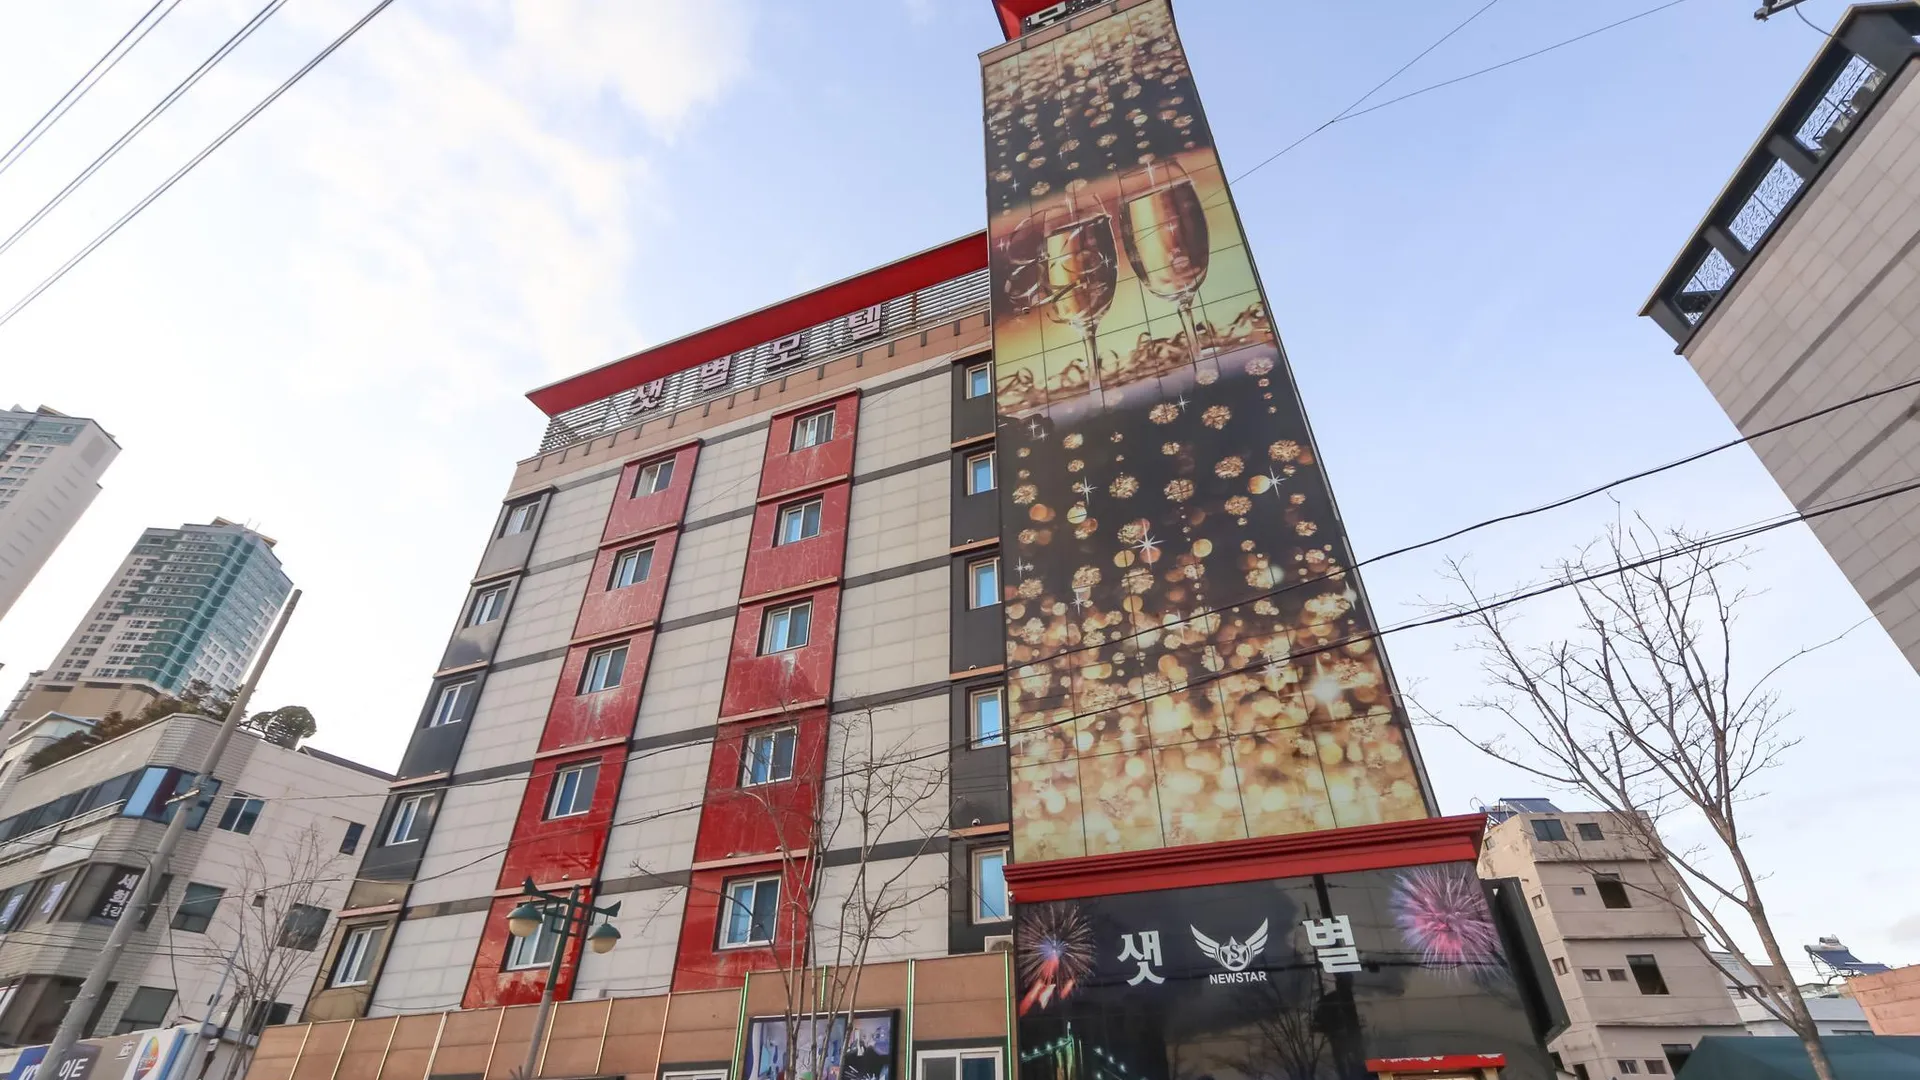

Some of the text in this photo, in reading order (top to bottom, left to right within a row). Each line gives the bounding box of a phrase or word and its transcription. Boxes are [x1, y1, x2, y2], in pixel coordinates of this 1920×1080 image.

[1117, 930, 1165, 987] 샛
[1302, 915, 1362, 973] 별
[1209, 971, 1267, 985] NEWSTAR
